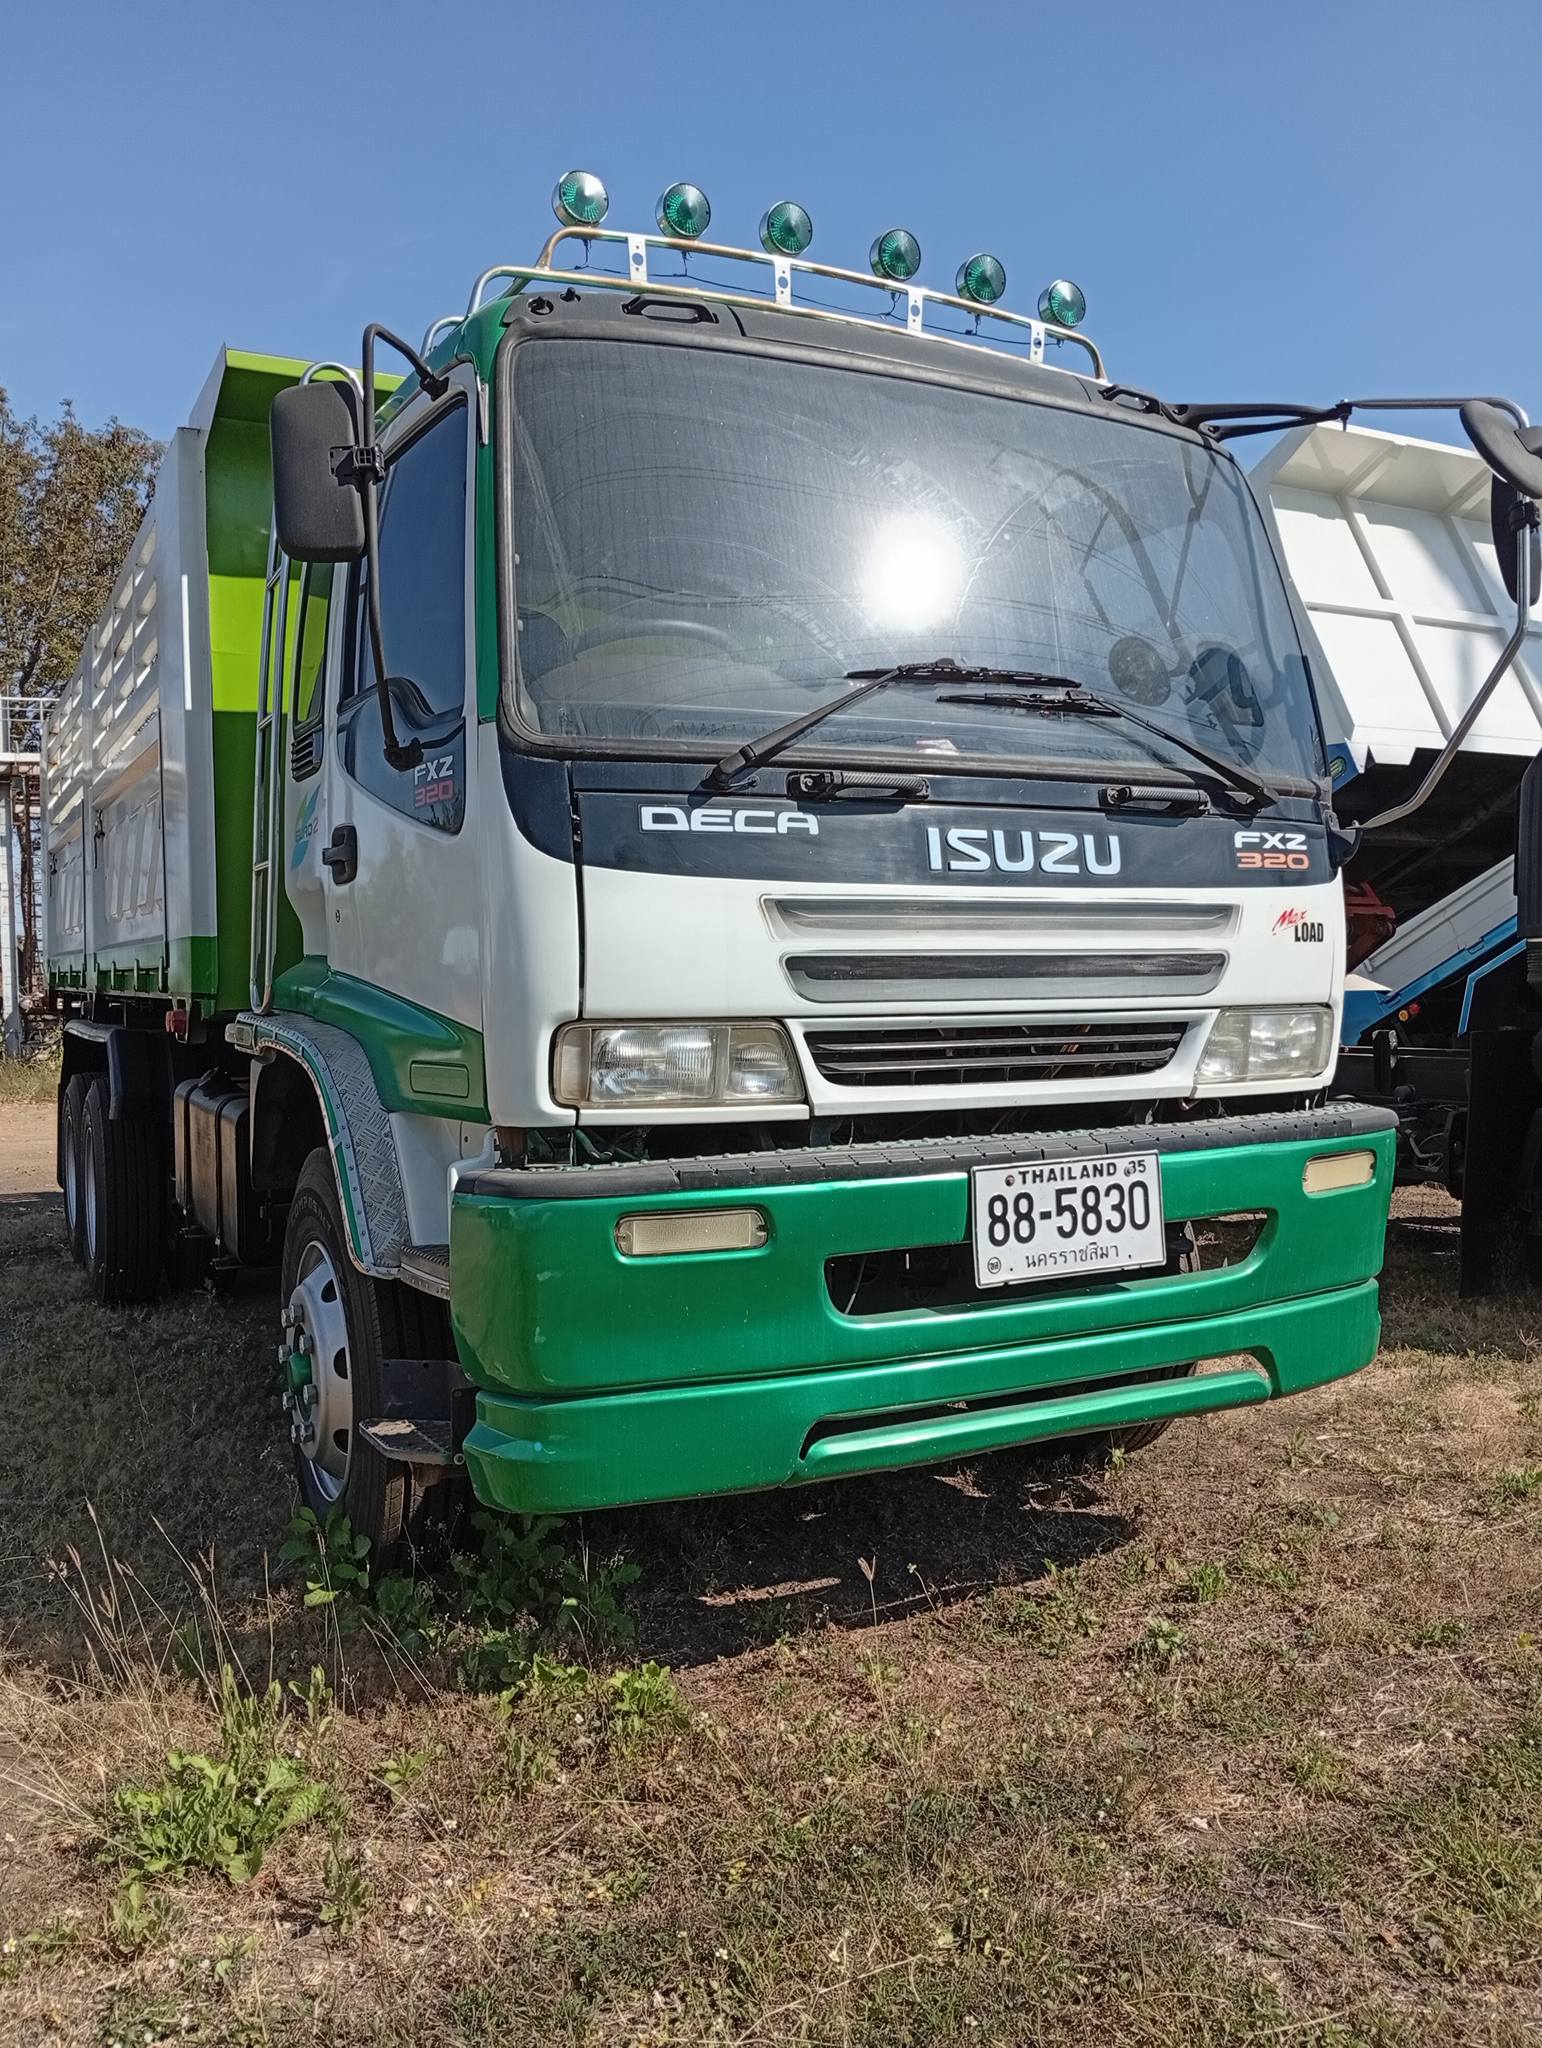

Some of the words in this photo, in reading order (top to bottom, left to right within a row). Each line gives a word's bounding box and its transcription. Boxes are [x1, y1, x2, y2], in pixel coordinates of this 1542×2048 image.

[414, 755, 454, 785] FXZ
[414, 779, 454, 807] 320
[640, 806, 819, 835] DECA
[927, 827, 1121, 875] ISUZU
[1234, 831, 1308, 850] FXZ
[1236, 852, 1310, 869] 320
[1271, 908, 1308, 936] Max
[1294, 922, 1324, 942] LOAD
[1018, 1162, 1118, 1185] THAILAND
[987, 1180, 1151, 1247] 88-5830
[1025, 1242, 1120, 1268] นครราชสีมา
